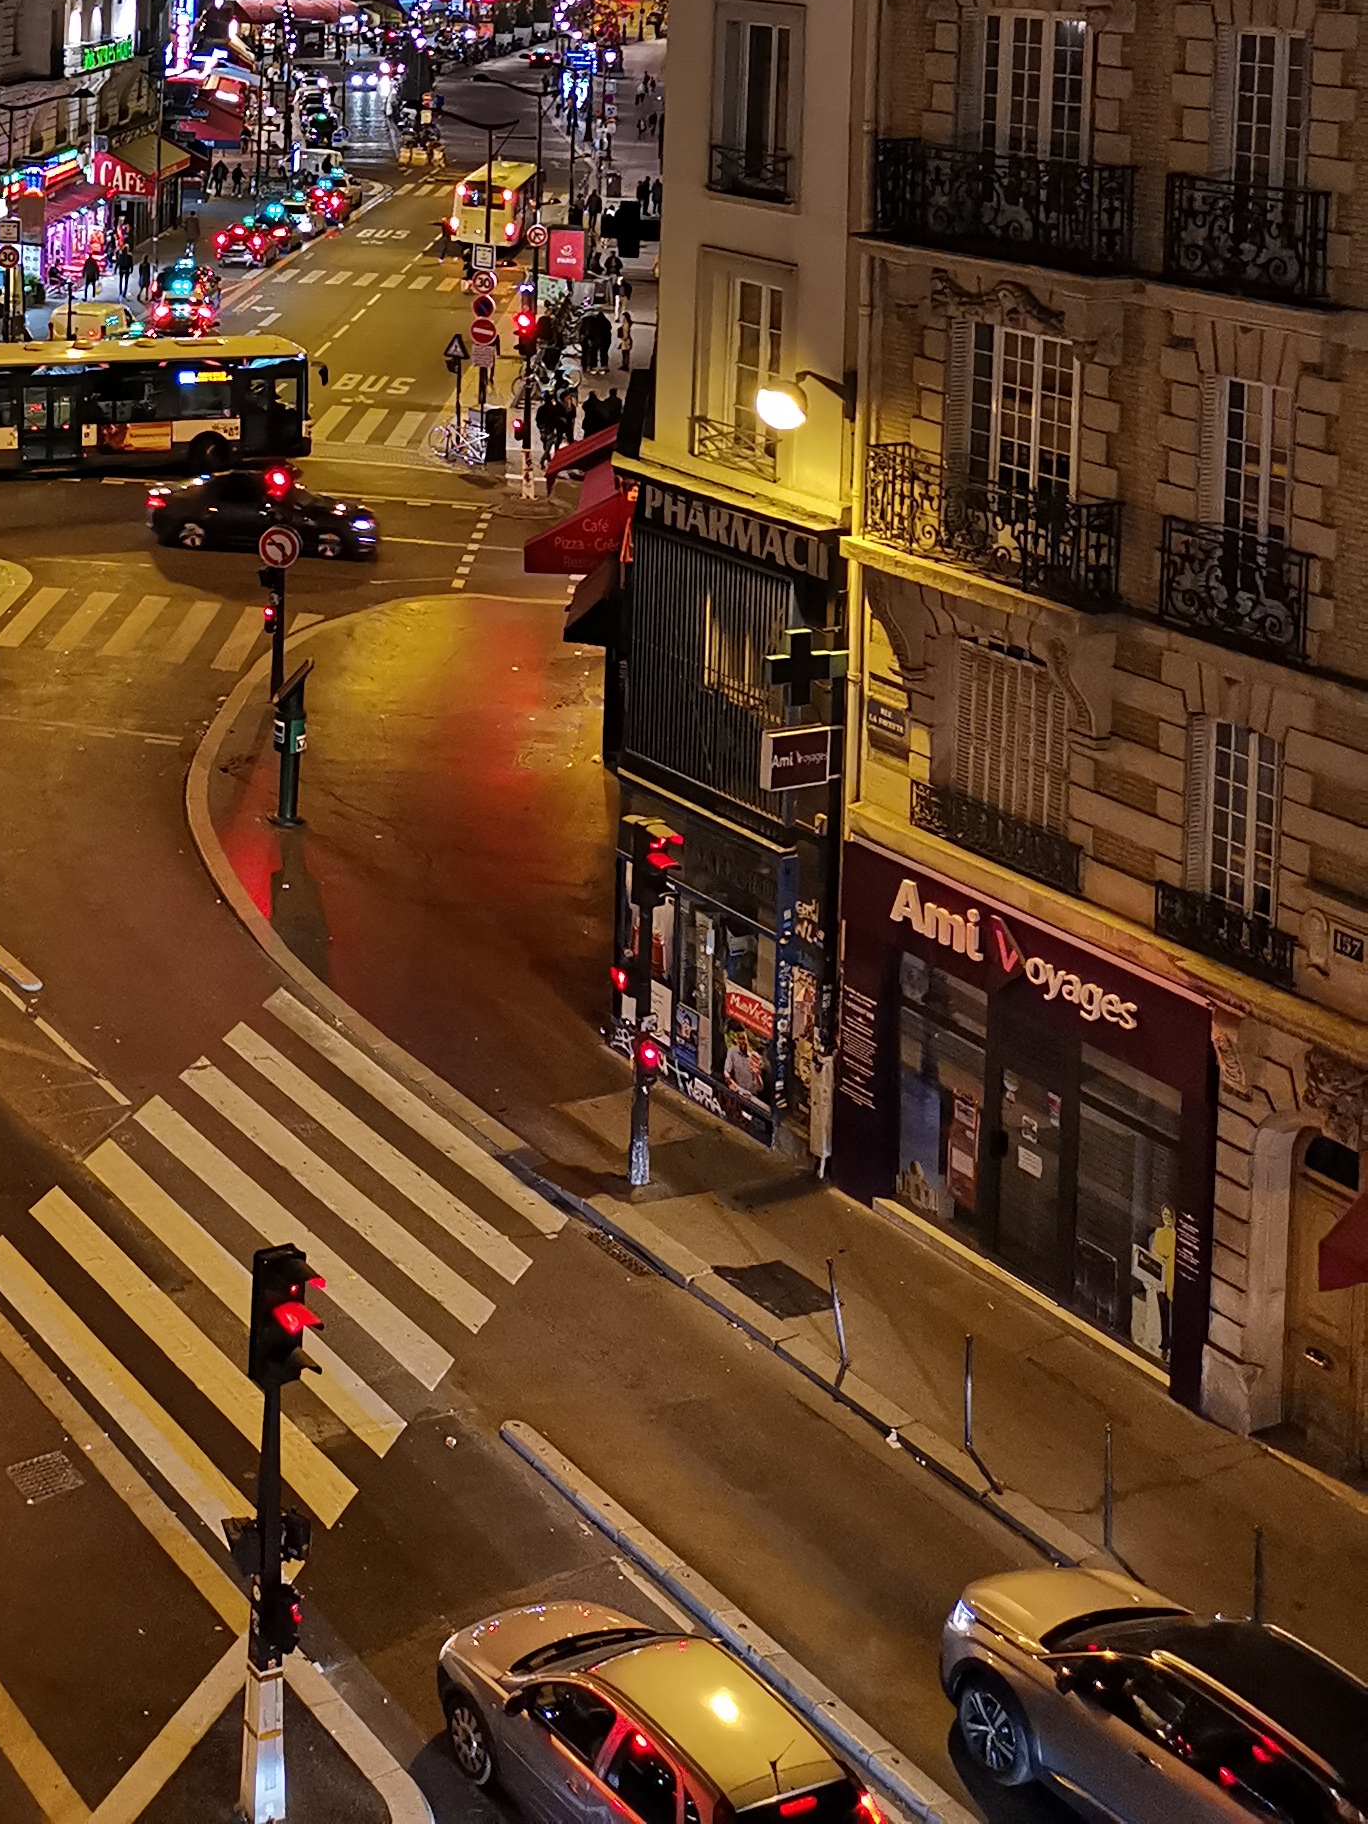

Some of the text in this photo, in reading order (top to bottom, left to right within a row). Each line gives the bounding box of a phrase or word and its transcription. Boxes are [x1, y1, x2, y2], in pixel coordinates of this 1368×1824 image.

[356, 228, 411, 240] BUS
[1, 251, 16, 263] 30
[478, 277, 491, 289] 30
[331, 373, 416, 395] BUS
[582, 518, 609, 532] Café
[554, 537, 585, 550] Pizza
[772, 751, 794, 768] Ami
[1336, 932, 1362, 956] 157
[889, 879, 984, 962] Ami
[989, 914, 1139, 1030] Voyages
